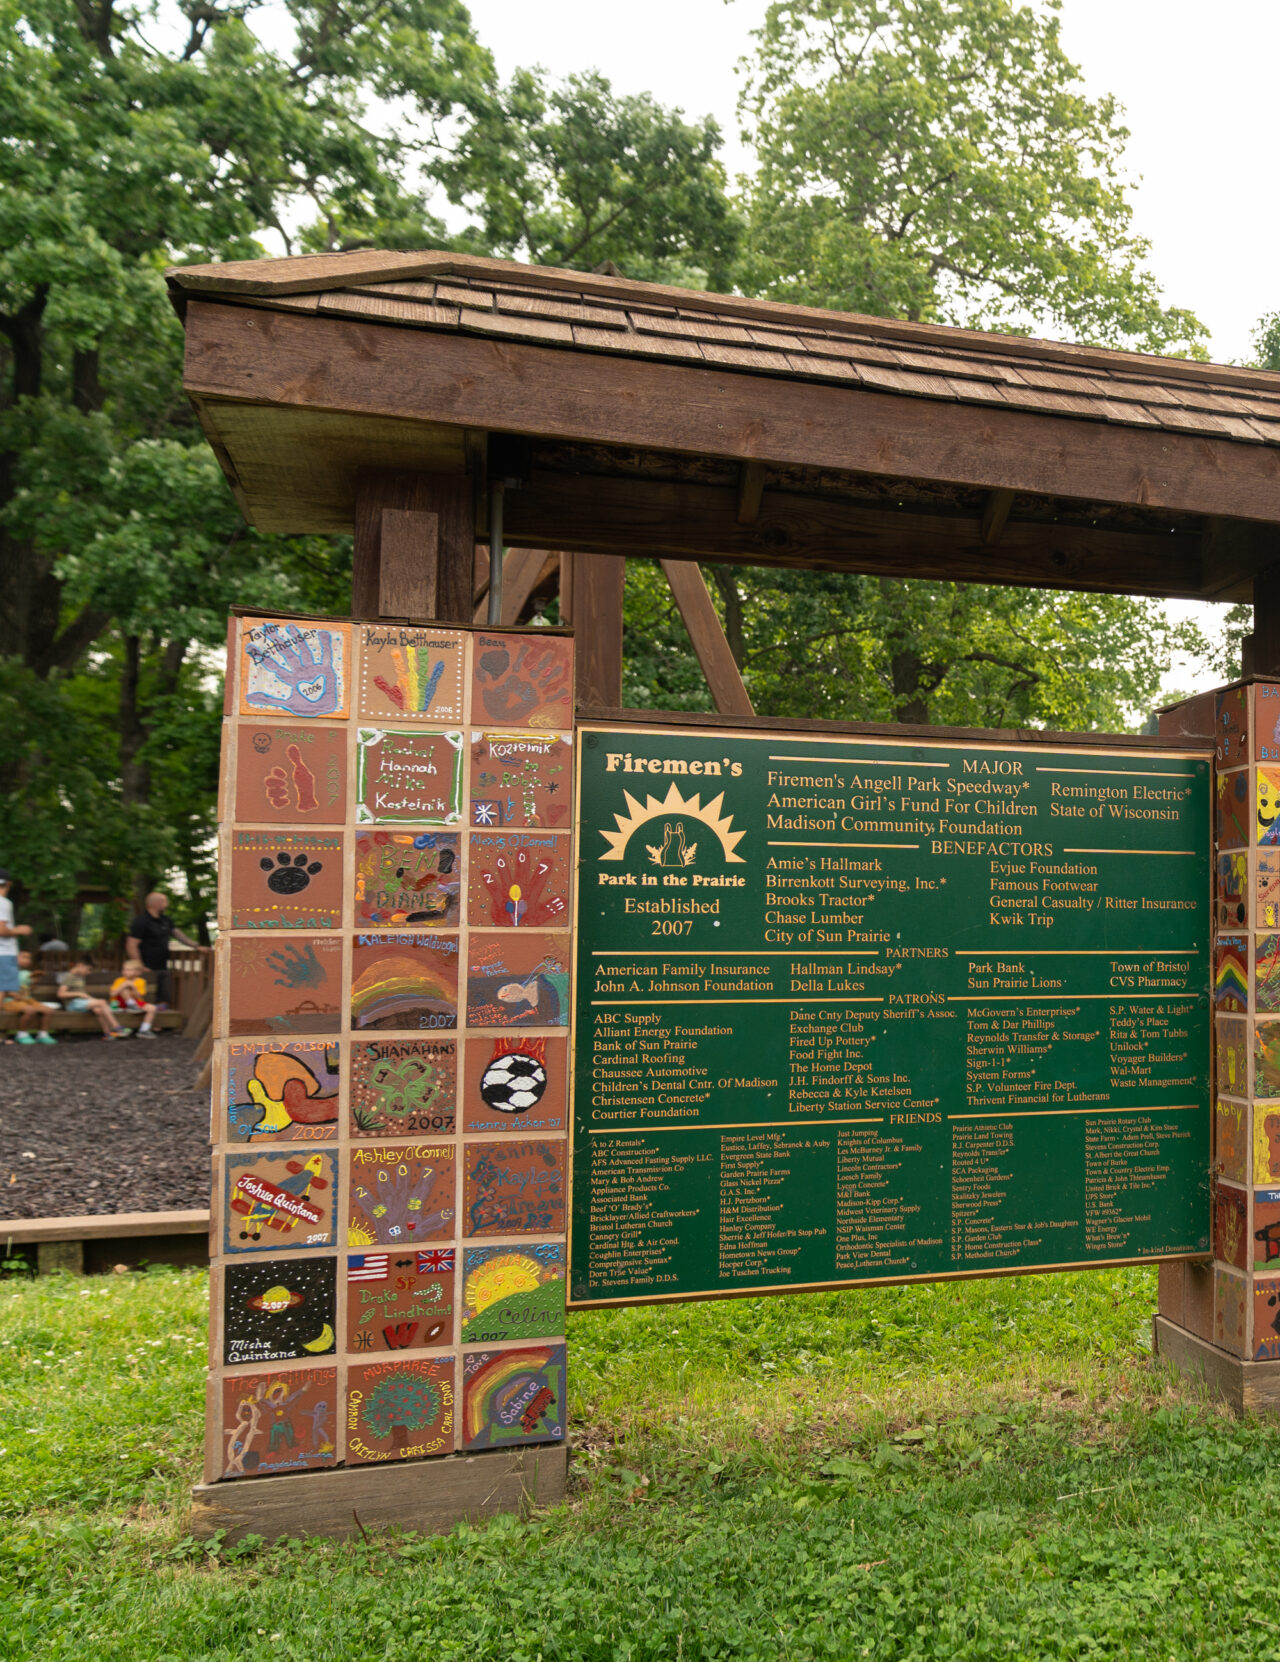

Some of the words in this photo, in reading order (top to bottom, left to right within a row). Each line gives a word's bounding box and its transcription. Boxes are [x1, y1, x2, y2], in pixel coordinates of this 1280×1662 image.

[244, 623, 280, 642] Taylor
[251, 629, 317, 665] Betthauser
[366, 629, 397, 653] Kayla
[400, 630, 459, 649] Betthauser
[302, 683, 323, 696] 2006
[435, 706, 453, 714] 2006
[379, 757, 438, 775] Hannah
[604, 752, 743, 777] Firemen's
[962, 758, 1023, 776] MAJOR
[375, 773, 425, 790] Mike
[766, 770, 845, 789] Firemen's
[849, 774, 902, 794] Angell
[907, 775, 941, 792] Park
[1050, 781, 1128, 802] Remington
[766, 792, 846, 810] American
[849, 794, 896, 811] Girl's
[900, 796, 940, 813] Fund
[944, 797, 971, 814] For
[973, 798, 1038, 816] Children
[1049, 801, 1085, 818] State
[1088, 802, 1106, 818] of
[1107, 803, 1179, 820] Wisconsin
[766, 813, 836, 831] Madison
[840, 815, 935, 837] Community
[938, 818, 1022, 836] Foundation
[470, 834, 506, 849] Alexis
[930, 839, 1053, 857] BENEFACTORS
[379, 845, 438, 872] BEN
[765, 855, 816, 870] Amie's
[819, 856, 883, 871] Hallmark
[989, 859, 1026, 877] Evjue
[1029, 860, 1098, 875] Foundation
[597, 872, 638, 886] Park
[640, 872, 658, 886] in
[662, 873, 688, 887] the
[691, 873, 746, 887] Prairie
[765, 873, 835, 889] Birrenkott
[838, 874, 911, 893] Surveying,
[989, 877, 1039, 891] Famous
[1041, 877, 1099, 892] Footwear
[376, 890, 437, 909] DIANE
[624, 897, 720, 914] Established
[765, 891, 815, 906] Brooks
[988, 894, 1038, 908] General
[1040, 894, 1094, 912] Casualty
[1104, 895, 1139, 909] Ritter
[1140, 896, 1197, 910] Insurance
[764, 909, 807, 924] Chase
[810, 910, 864, 925] Lumber
[989, 911, 1024, 925] Kwik
[1026, 911, 1054, 929] Trip
[650, 919, 693, 936] 2007
[358, 934, 414, 947] KALEIGH
[763, 928, 794, 945] City
[797, 927, 815, 942] of
[815, 928, 843, 942] Sun
[846, 928, 891, 943] Prairie
[885, 946, 949, 958] PARTNERS
[594, 962, 658, 976] American
[661, 962, 707, 978] Family
[709, 962, 770, 975] Insurance
[790, 961, 844, 975] Hallman
[967, 961, 993, 974] Park
[996, 961, 1025, 974] Bank
[1109, 960, 1140, 973] Town
[1141, 960, 1156, 972] of
[1155, 960, 1190, 972] Bristol
[593, 979, 625, 993] John
[628, 979, 644, 992] A.
[647, 979, 700, 992] Johnson
[703, 978, 774, 992] Foundation
[790, 978, 824, 992] Della
[827, 978, 865, 992] Lukes
[966, 976, 990, 989] Sun
[992, 976, 1029, 989] Prairie
[1031, 976, 1062, 988] Lions
[1108, 975, 1135, 987] CVS
[1137, 975, 1187, 989] Pharmacy
[888, 992, 945, 1005] PATRONS
[419, 1014, 456, 1029] 2007
[593, 1012, 622, 1024] ABC
[623, 1012, 662, 1026] Supply
[789, 1022, 838, 1036] Exchange
[839, 1021, 864, 1033] Club
[231, 1042, 289, 1056] EMILY
[293, 1041, 336, 1052] OLSON
[366, 1042, 455, 1061] SHANAHANS
[592, 1039, 622, 1051] Bank
[623, 1039, 638, 1051] of
[638, 1039, 660, 1050] Sun
[662, 1038, 698, 1050] Prairie
[788, 1062, 809, 1073] The
[810, 1061, 841, 1073] Home
[842, 1060, 873, 1074] Depot
[1109, 1064, 1152, 1076] Wal-Mart
[468, 1120, 507, 1130] Henry
[511, 1116, 545, 1129] Acker
[889, 1111, 942, 1125] FRIENDS
[1216, 1100, 1242, 1131] Abby
[238, 1124, 278, 1135] OLSON
[408, 1116, 455, 1131] 2007
[292, 1125, 336, 1141] 2007
[836, 1129, 851, 1138] Just
[849, 1128, 879, 1138] Jumping
[353, 1148, 404, 1165] Ashley
[405, 1144, 455, 1161] O'Connell
[836, 1155, 861, 1165] Liberty
[860, 1153, 885, 1163] Mutual
[238, 1176, 274, 1203] Joshua
[273, 1193, 320, 1224] Quintana
[589, 1193, 629, 1204] Associated
[628, 1192, 648, 1202] Bank
[588, 1221, 614, 1232] Bristol
[614, 1221, 647, 1231] Lutheran
[646, 1218, 673, 1228] Church
[306, 1233, 329, 1244] 2007
[359, 1289, 399, 1304] Drake
[261, 1300, 290, 1310] 2007
[384, 1304, 453, 1319] Lindholm!
[230, 1339, 272, 1350] Misha
[228, 1351, 297, 1363] Quintana
[363, 1360, 441, 1381] MURPHREE
[501, 1381, 540, 1425] Sabine
